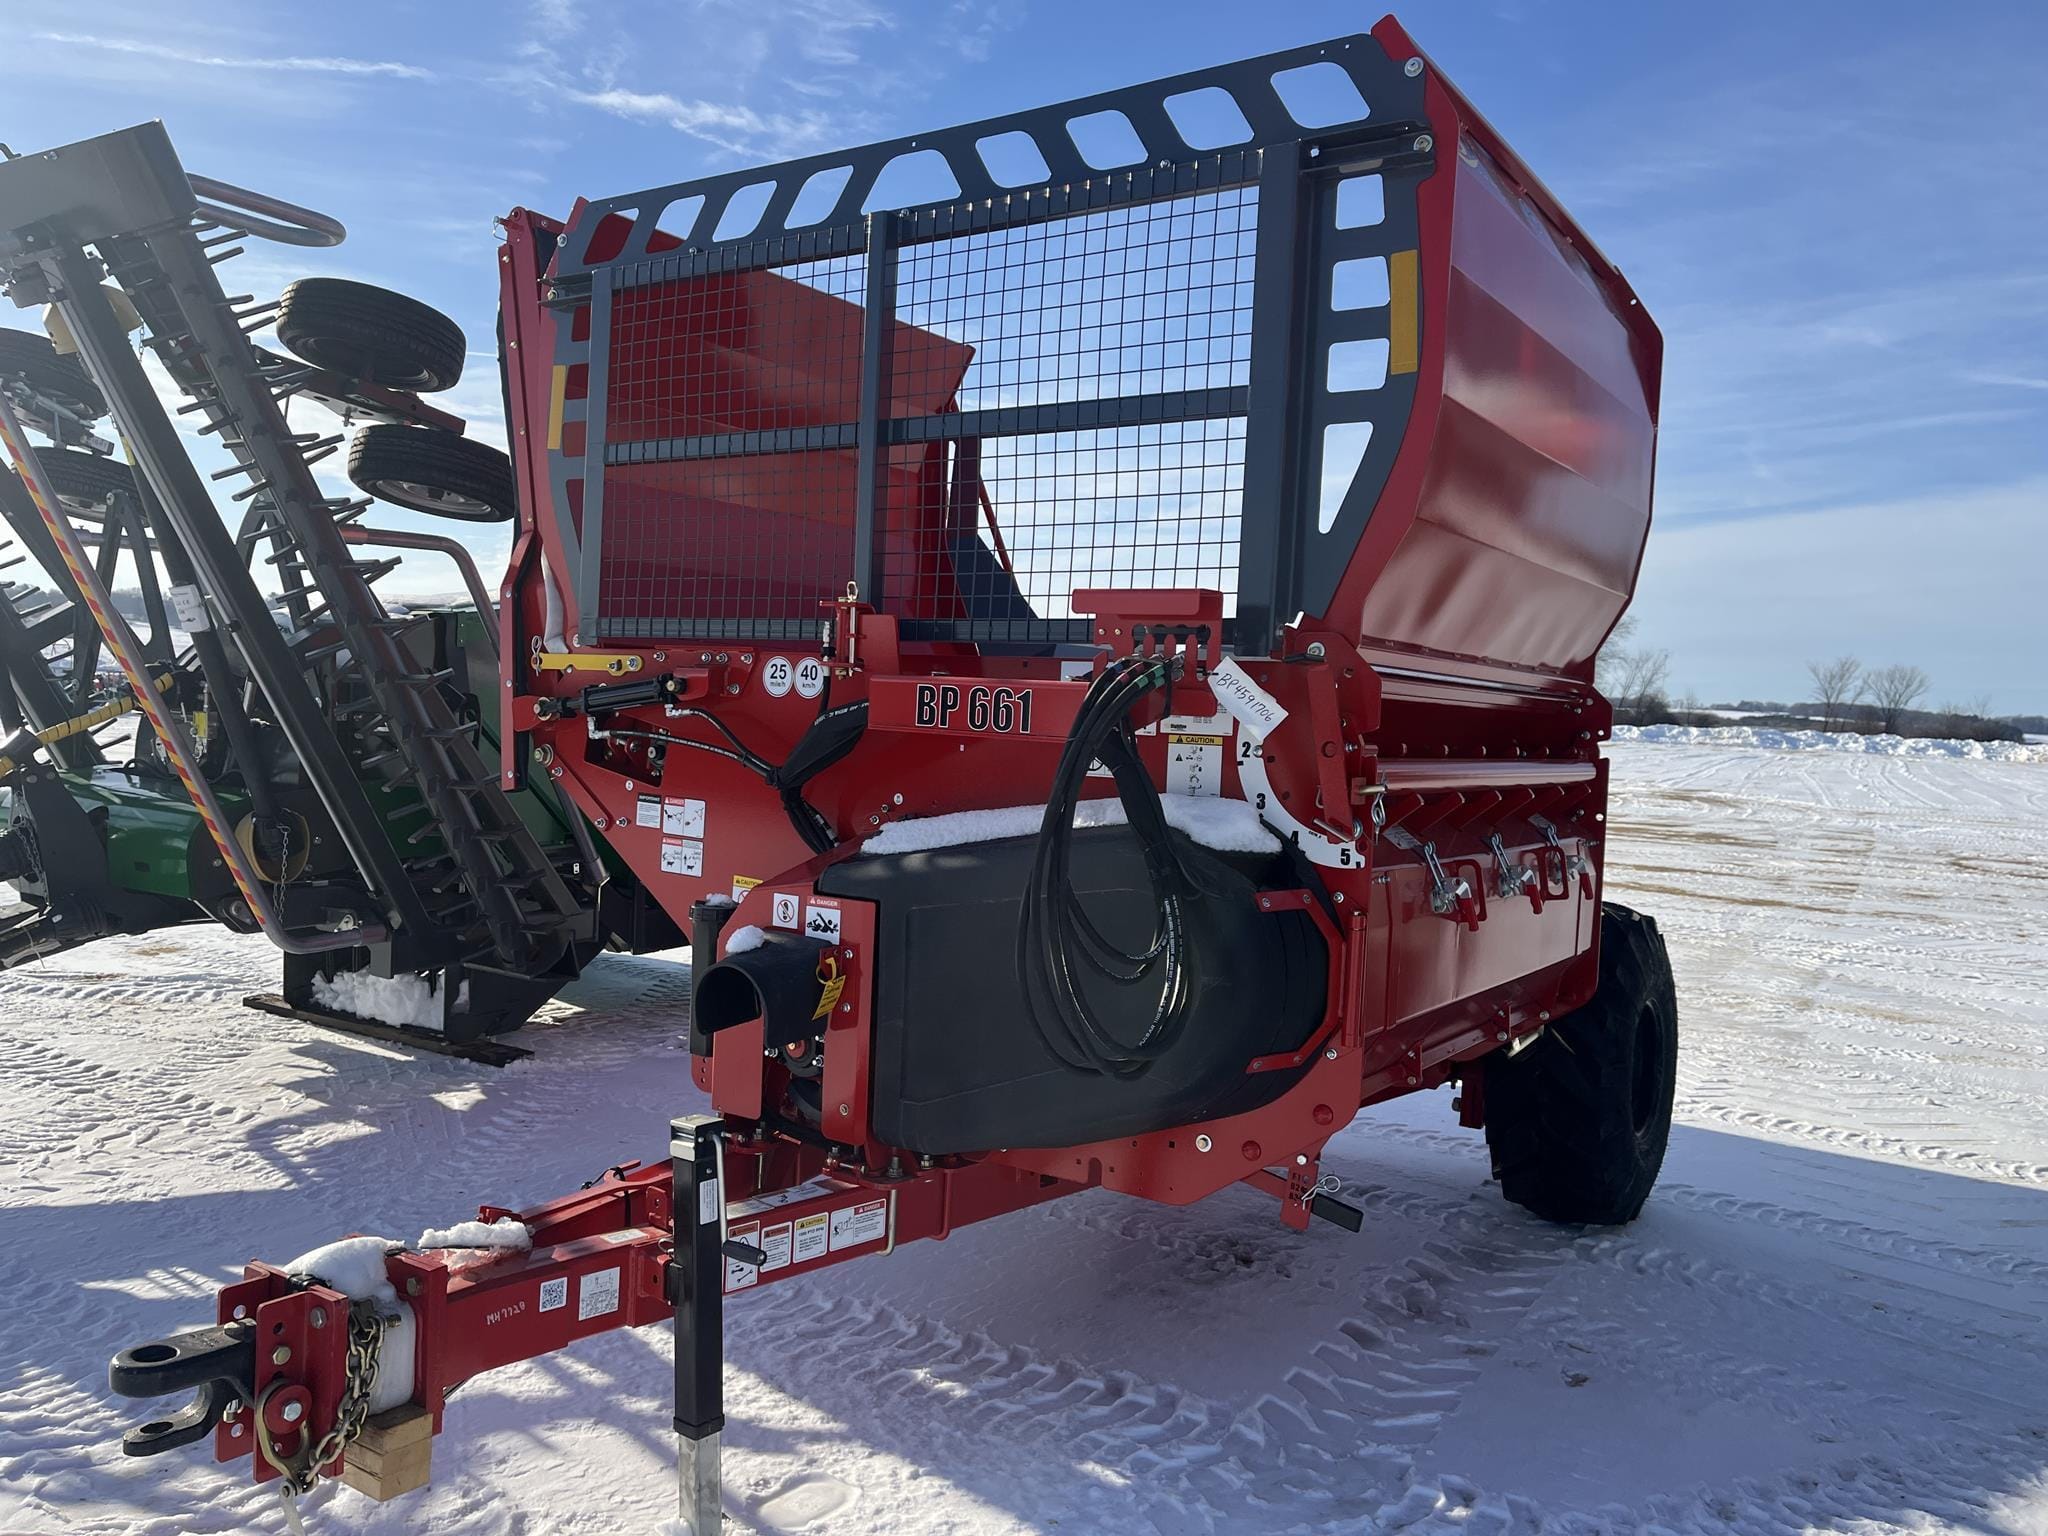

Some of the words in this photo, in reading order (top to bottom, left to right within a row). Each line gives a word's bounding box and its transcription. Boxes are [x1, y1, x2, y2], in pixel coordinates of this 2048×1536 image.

[769, 663, 787, 680] 25
[800, 664, 818, 681] 40
[915, 683, 960, 729] BP
[967, 685, 1033, 734] 661
[1185, 736, 1215, 744] CAUTION
[1241, 741, 1251, 758] 2
[1256, 792, 1266, 810] 3
[1289, 830, 1300, 847] 4
[1340, 848, 1351, 866] 5
[741, 879, 759, 887] CAUTI
[816, 898, 838, 907] DANGER
